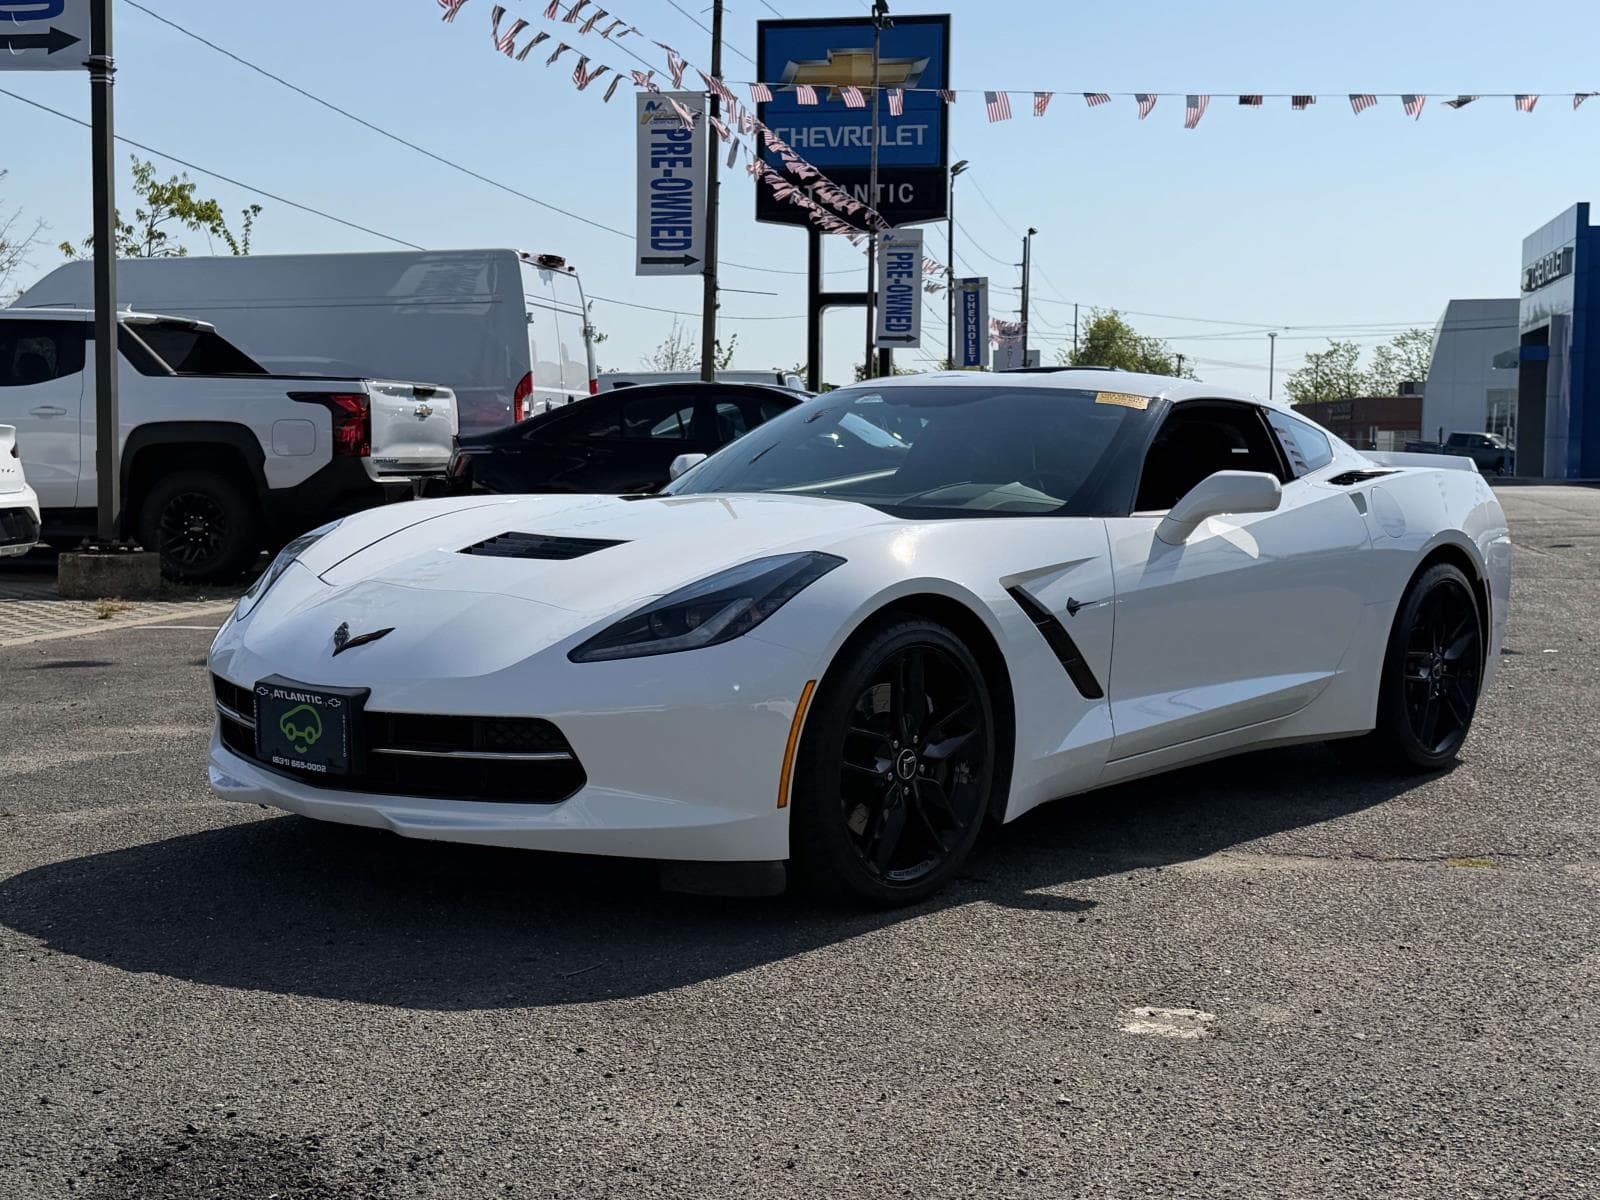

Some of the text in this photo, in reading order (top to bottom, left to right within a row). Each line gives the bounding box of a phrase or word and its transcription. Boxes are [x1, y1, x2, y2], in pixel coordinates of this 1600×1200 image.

[775, 124, 928, 148] CHEVROLET
[650, 129, 693, 251] PRE-OWNED
[885, 252, 914, 332] PRE-OWNED
[967, 293, 977, 362] CHEVROLET
[273, 689, 322, 705] ATLANTIC
